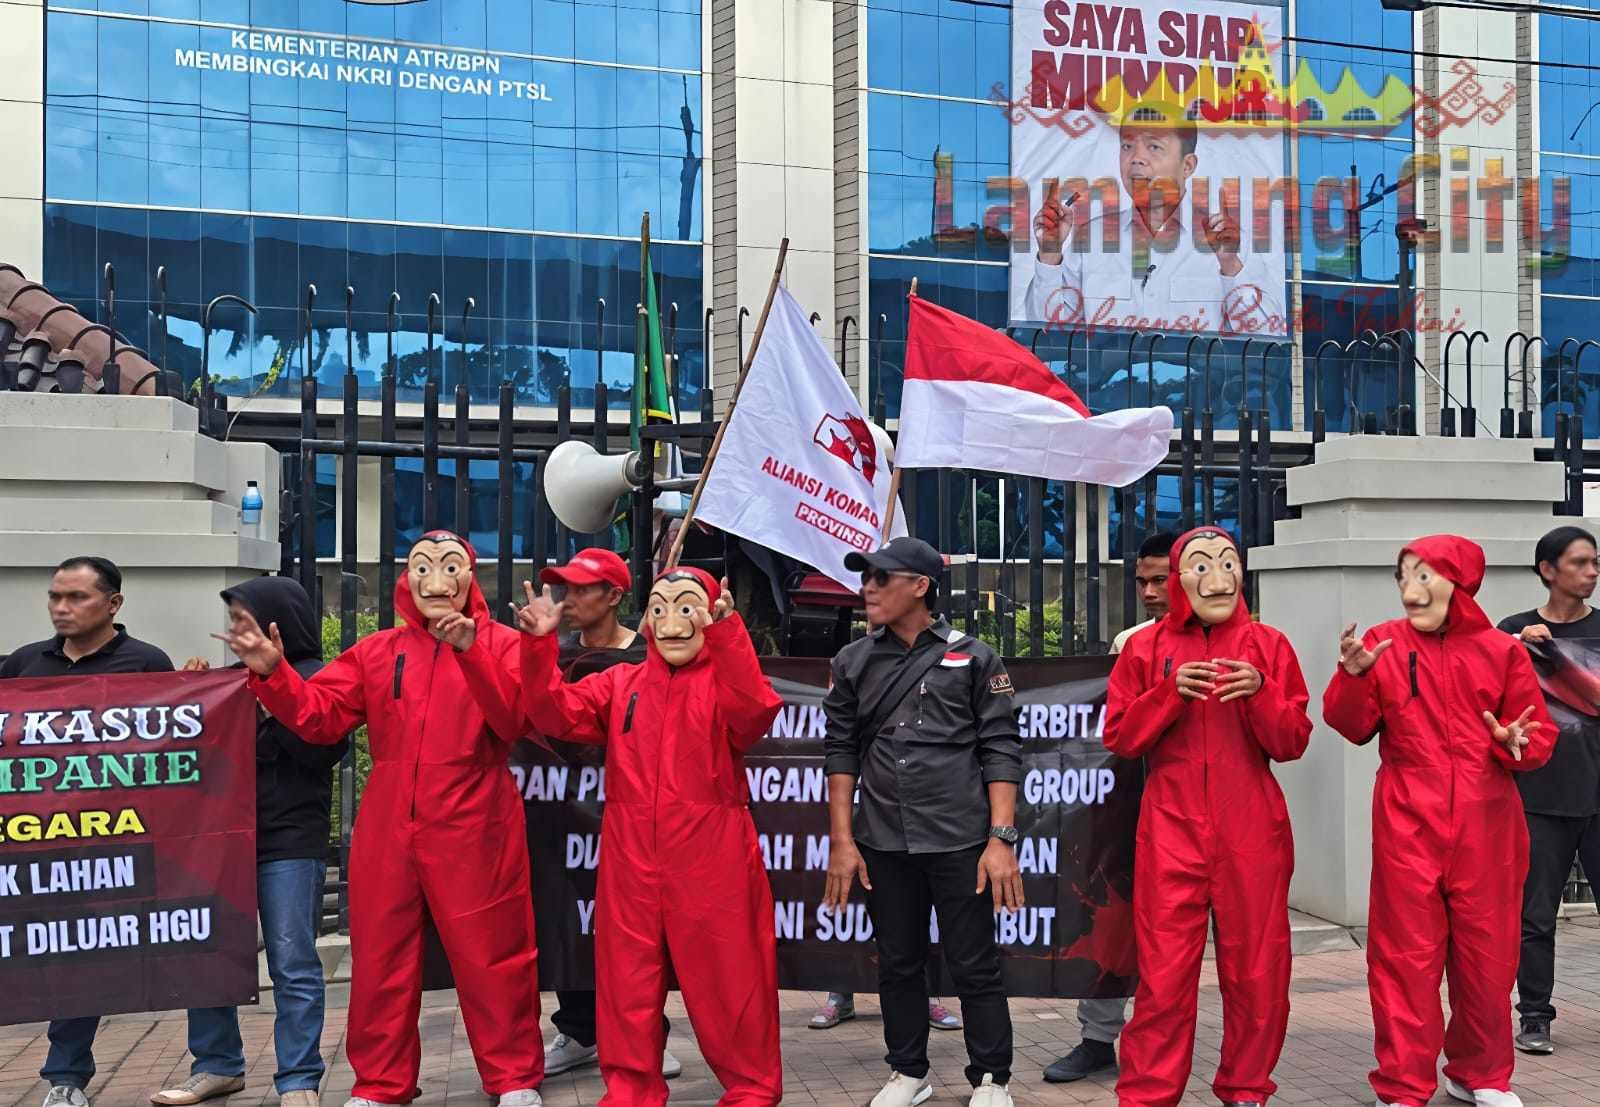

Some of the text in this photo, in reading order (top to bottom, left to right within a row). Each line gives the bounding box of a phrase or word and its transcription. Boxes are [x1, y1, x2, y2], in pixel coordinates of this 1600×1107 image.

[231, 30, 500, 74] KEMENTERIAN ATR/BPN
[1043, 0, 1255, 62] SAYA SIAP
[175, 48, 553, 101] MEMBINGKAI NKRI DENGAN PTSL
[1031, 50, 1268, 126] MUNDUR
[761, 456, 823, 497] ALIANSI
[799, 505, 871, 550] PROVINSI
[20, 704, 203, 745] KASUS
[1024, 768, 1115, 805] GROUP
[0, 808, 146, 843] GARA
[30, 855, 135, 894] LAHAN
[27, 914, 139, 955] DILUAR
[149, 907, 211, 944] HGU
